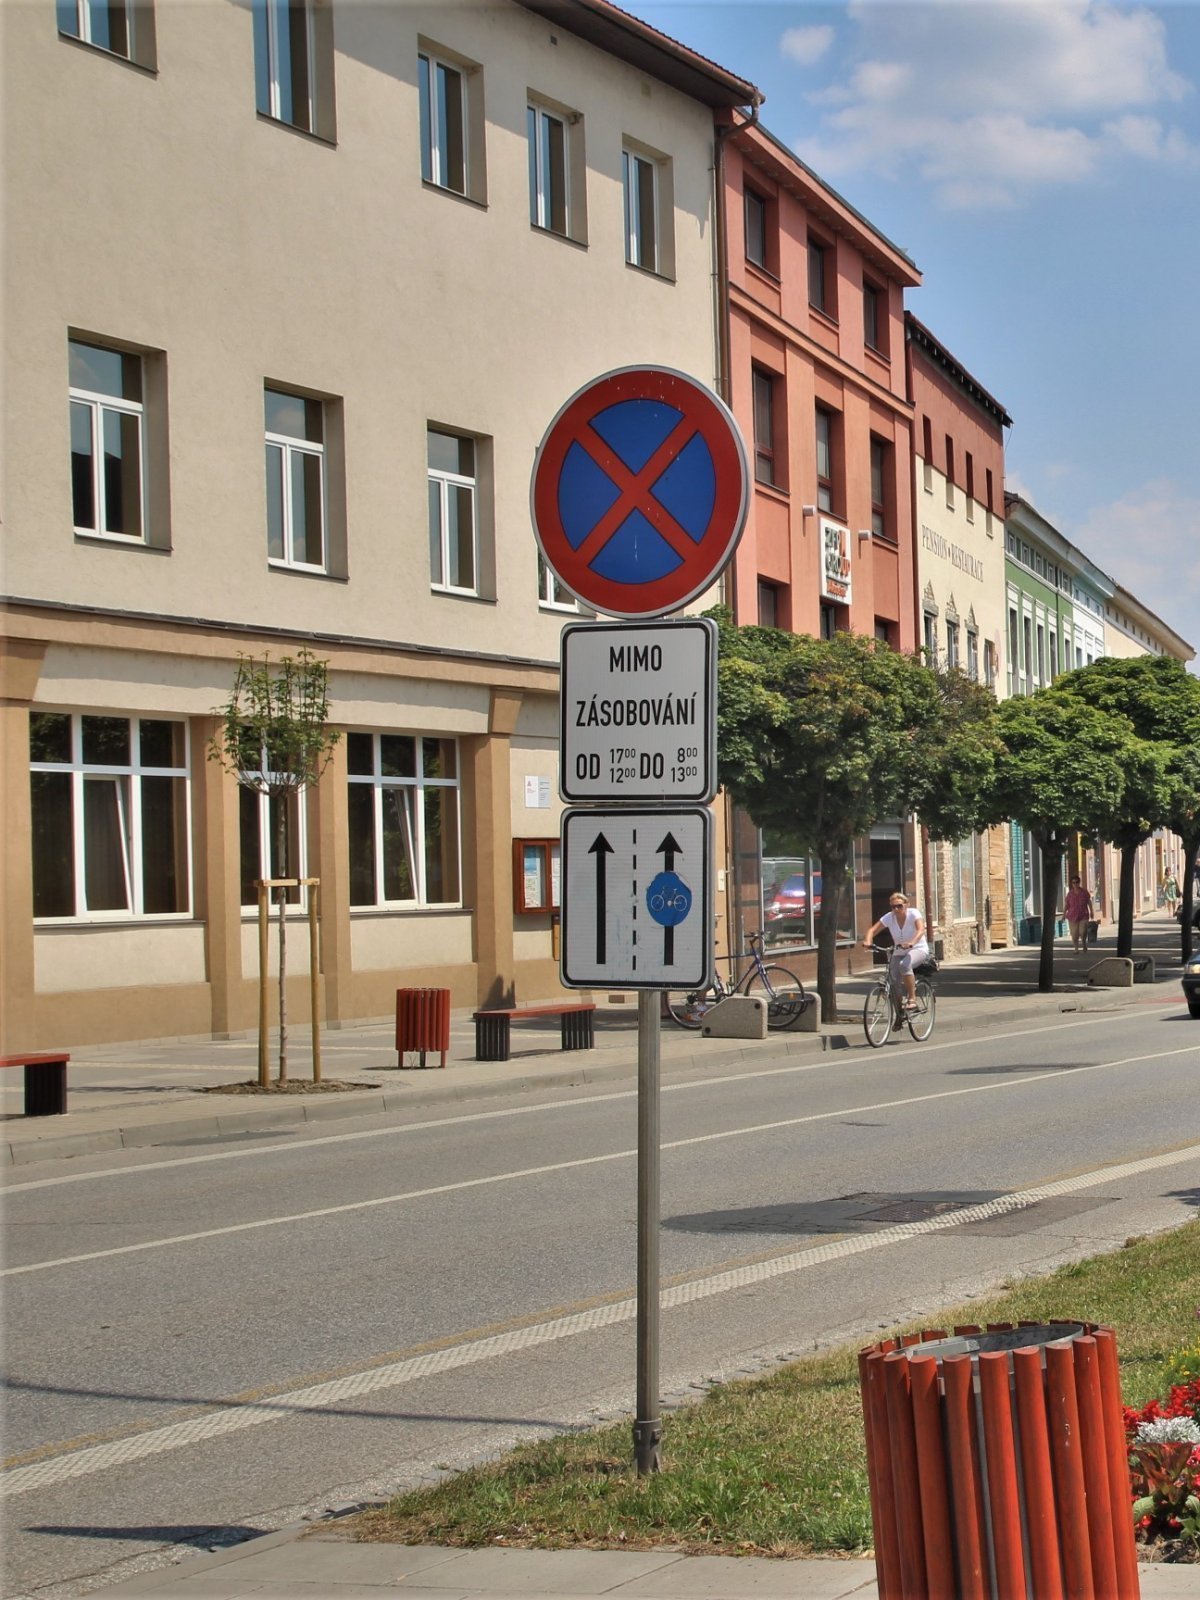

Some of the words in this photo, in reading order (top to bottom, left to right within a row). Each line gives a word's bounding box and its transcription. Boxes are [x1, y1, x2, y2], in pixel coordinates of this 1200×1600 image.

[922, 524, 948, 560] PENSION
[609, 644, 662, 673] MIMO
[576, 691, 697, 727] ZÁSOBOVÁNÍ
[576, 753, 600, 780] OD
[640, 752, 664, 780] DO
